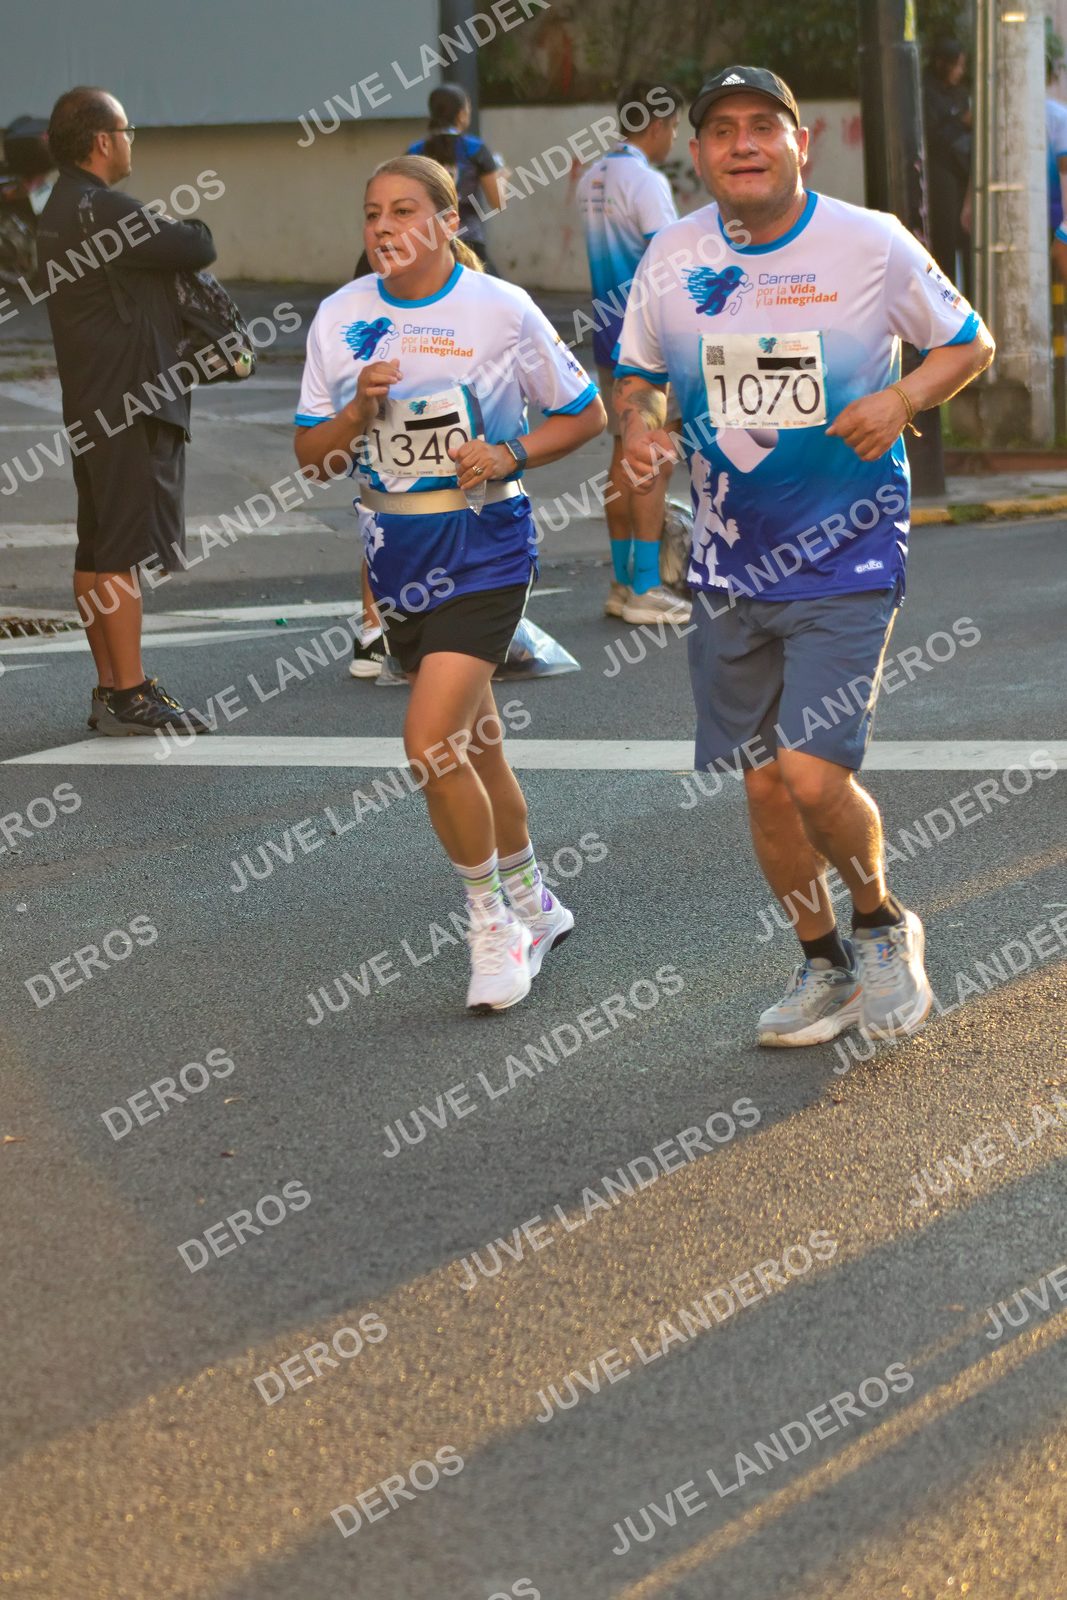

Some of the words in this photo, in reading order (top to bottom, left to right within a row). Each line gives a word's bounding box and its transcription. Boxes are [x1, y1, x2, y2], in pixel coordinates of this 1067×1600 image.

[758, 273, 816, 286] Carrera
[757, 287, 774, 297] por
[777, 286, 787, 296] la
[790, 284, 816, 294] Vida
[756, 299, 762, 309] y
[764, 297, 773, 306] la
[776, 292, 838, 307] Integridad
[402, 323, 455, 337] Carrera
[402, 336, 418, 346] por
[420, 336, 429, 345] la
[431, 336, 455, 347] Vida
[401, 345, 406, 355] y
[408, 345, 417, 353] la
[420, 345, 474, 358] Integridad
[713, 374, 820, 416] 1070
[372, 427, 469, 467] 1340
